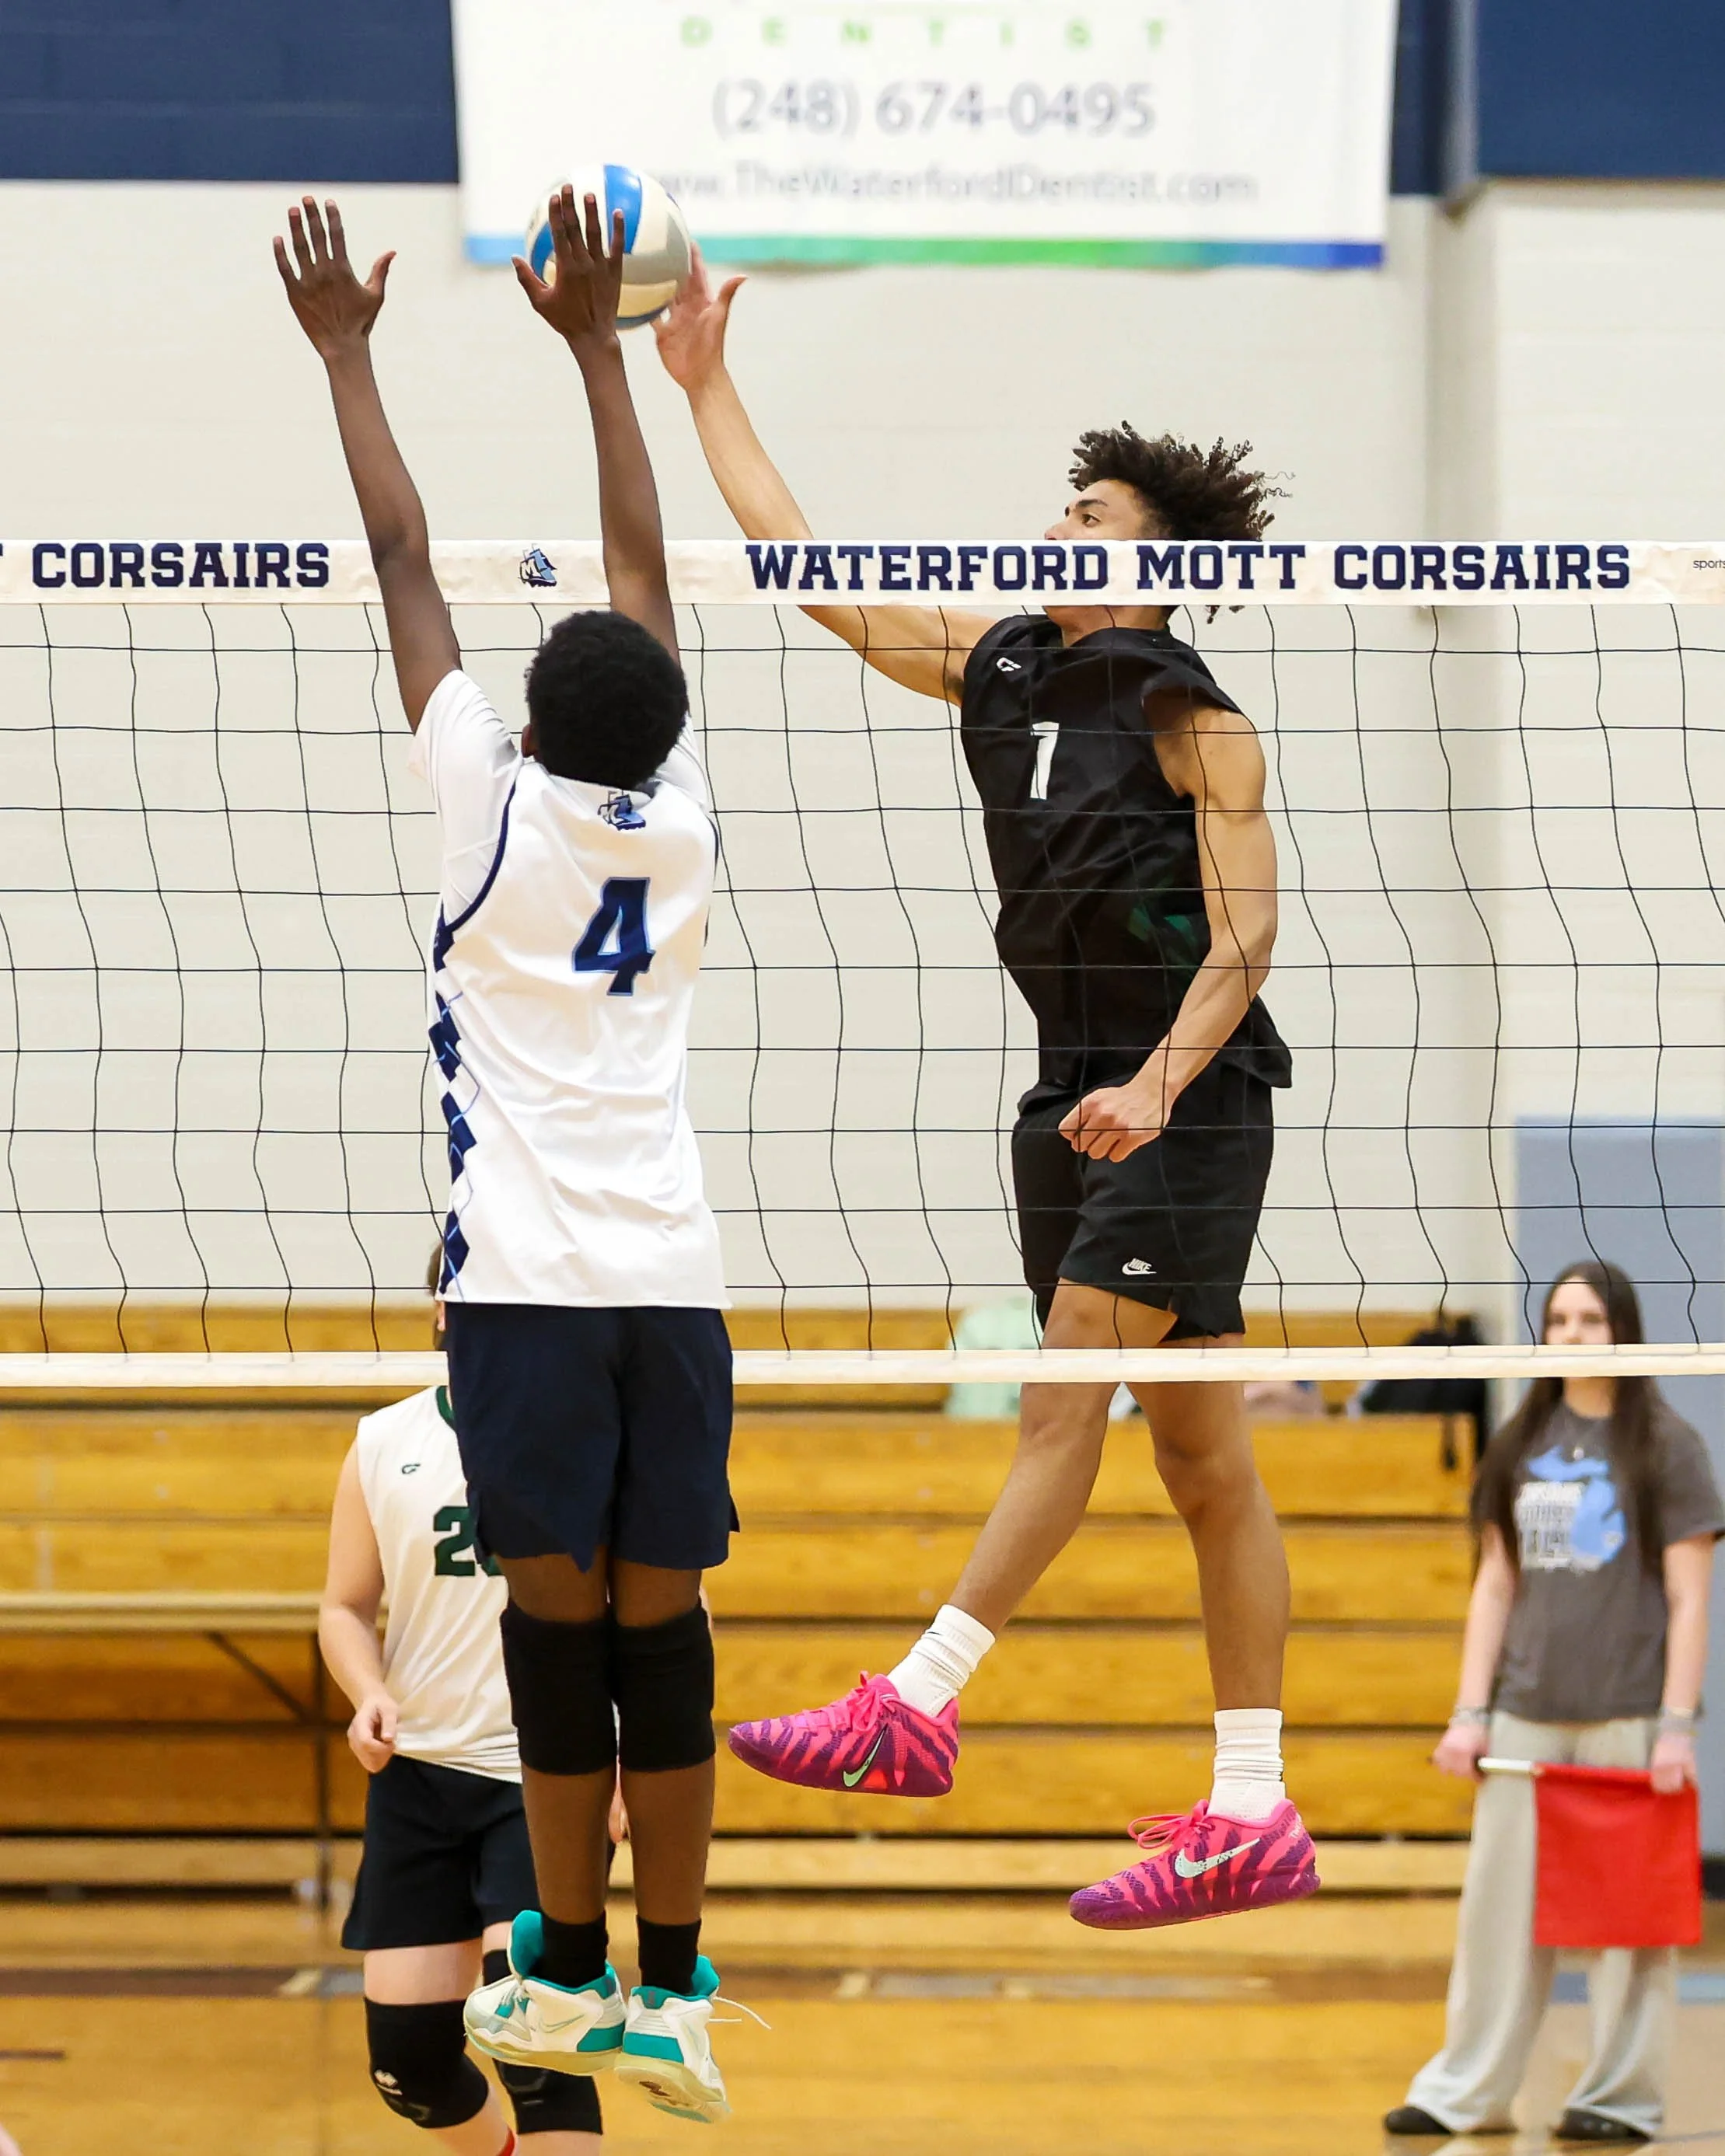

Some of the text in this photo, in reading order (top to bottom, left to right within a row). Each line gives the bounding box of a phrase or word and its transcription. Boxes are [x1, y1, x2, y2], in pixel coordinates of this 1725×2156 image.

[679, 16, 1166, 48] DENTIST
[711, 78, 1158, 141] (248) 674-0495
[33, 542, 330, 588] CORSAIRS
[745, 544, 1630, 591] WATERFORD MOTT CORSAIRS
[571, 877, 656, 996] 4
[432, 1505, 505, 1577] 2
